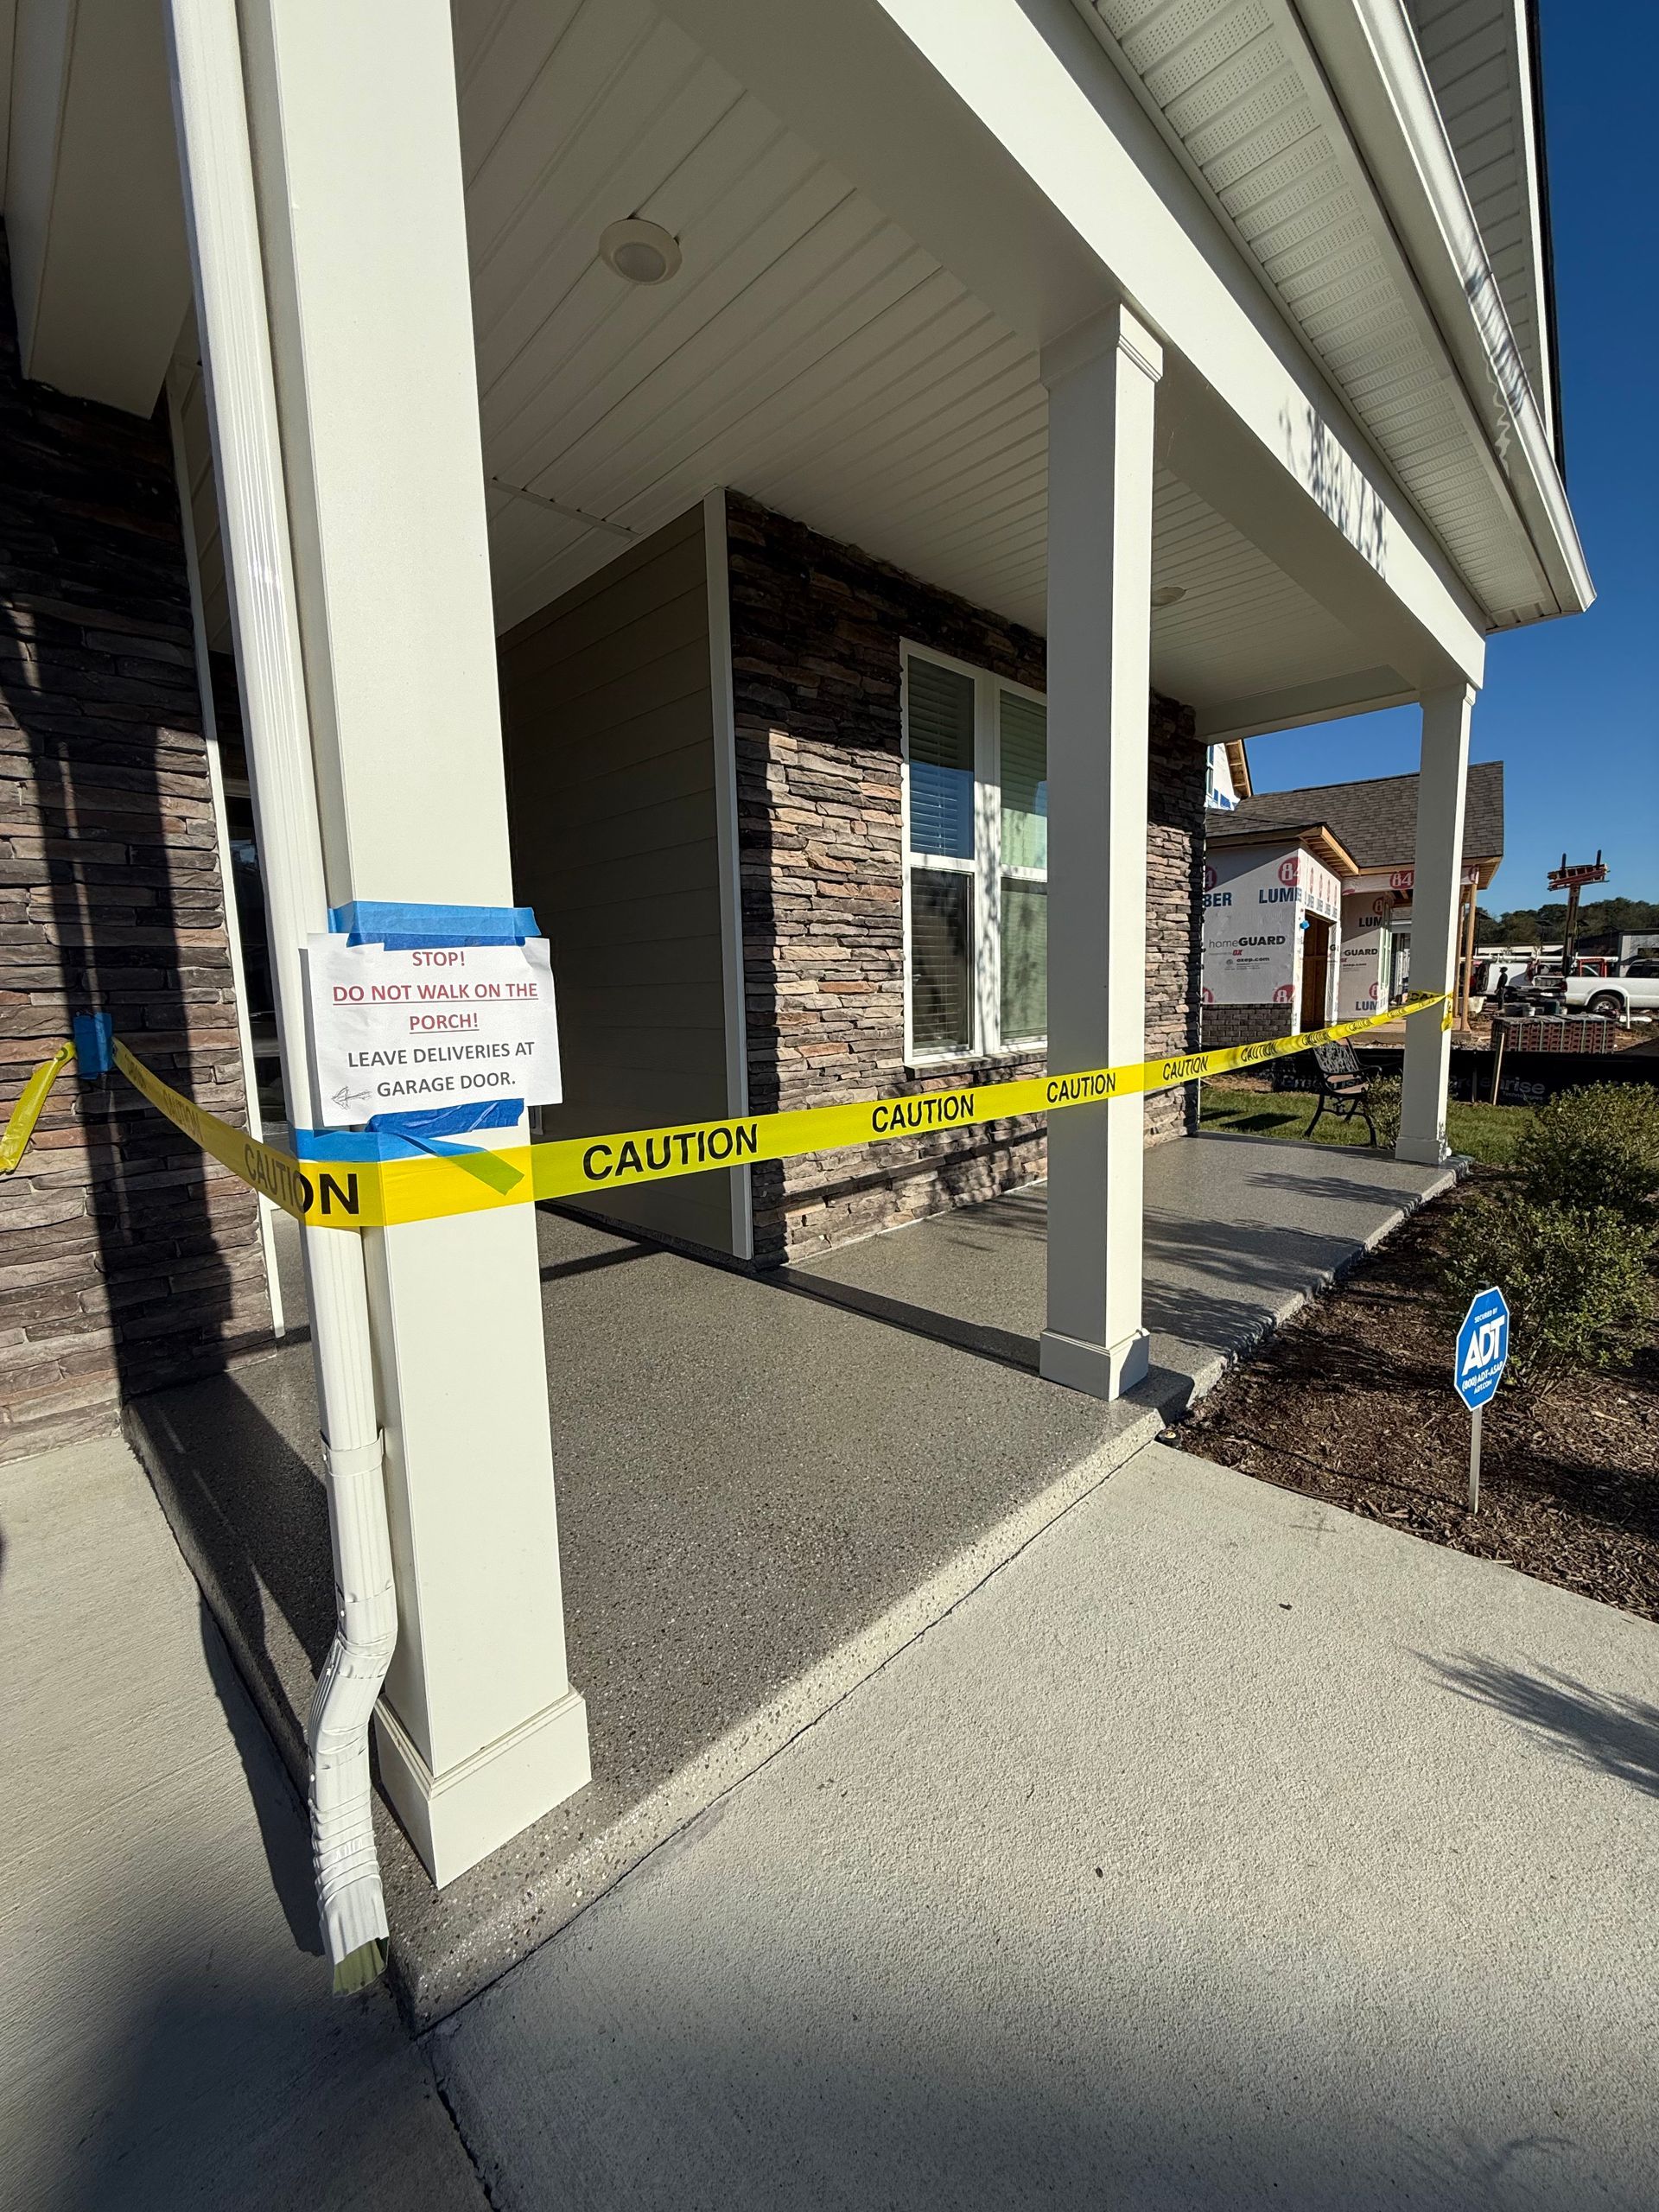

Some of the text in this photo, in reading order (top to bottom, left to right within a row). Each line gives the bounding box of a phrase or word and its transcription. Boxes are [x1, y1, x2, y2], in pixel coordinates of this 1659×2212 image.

[1392, 872, 1413, 888] 84
[1203, 887, 1302, 907] BER LUMB
[1358, 916, 1382, 928] LUM
[1209, 935, 1286, 949] homeGUARD
[1344, 948, 1378, 957] GUARD
[411, 950, 466, 967] STOP!
[333, 982, 538, 1002] DO NOT WALK ON THE
[409, 1012, 480, 1032] PORCH!
[347, 1040, 536, 1068] LEAVE DELIVERIES AT
[1240, 1041, 1277, 1062] CAUTION
[1162, 1055, 1209, 1081] CAUTION
[376, 1071, 517, 1098] GARAGE DOOR.
[1046, 1071, 1118, 1103] CAUTION
[870, 1093, 976, 1133] CAUTION
[582, 1122, 760, 1181] CAUTION
[245, 1143, 359, 1215] CAUTION
[1461, 1314, 1505, 1376] ADT
